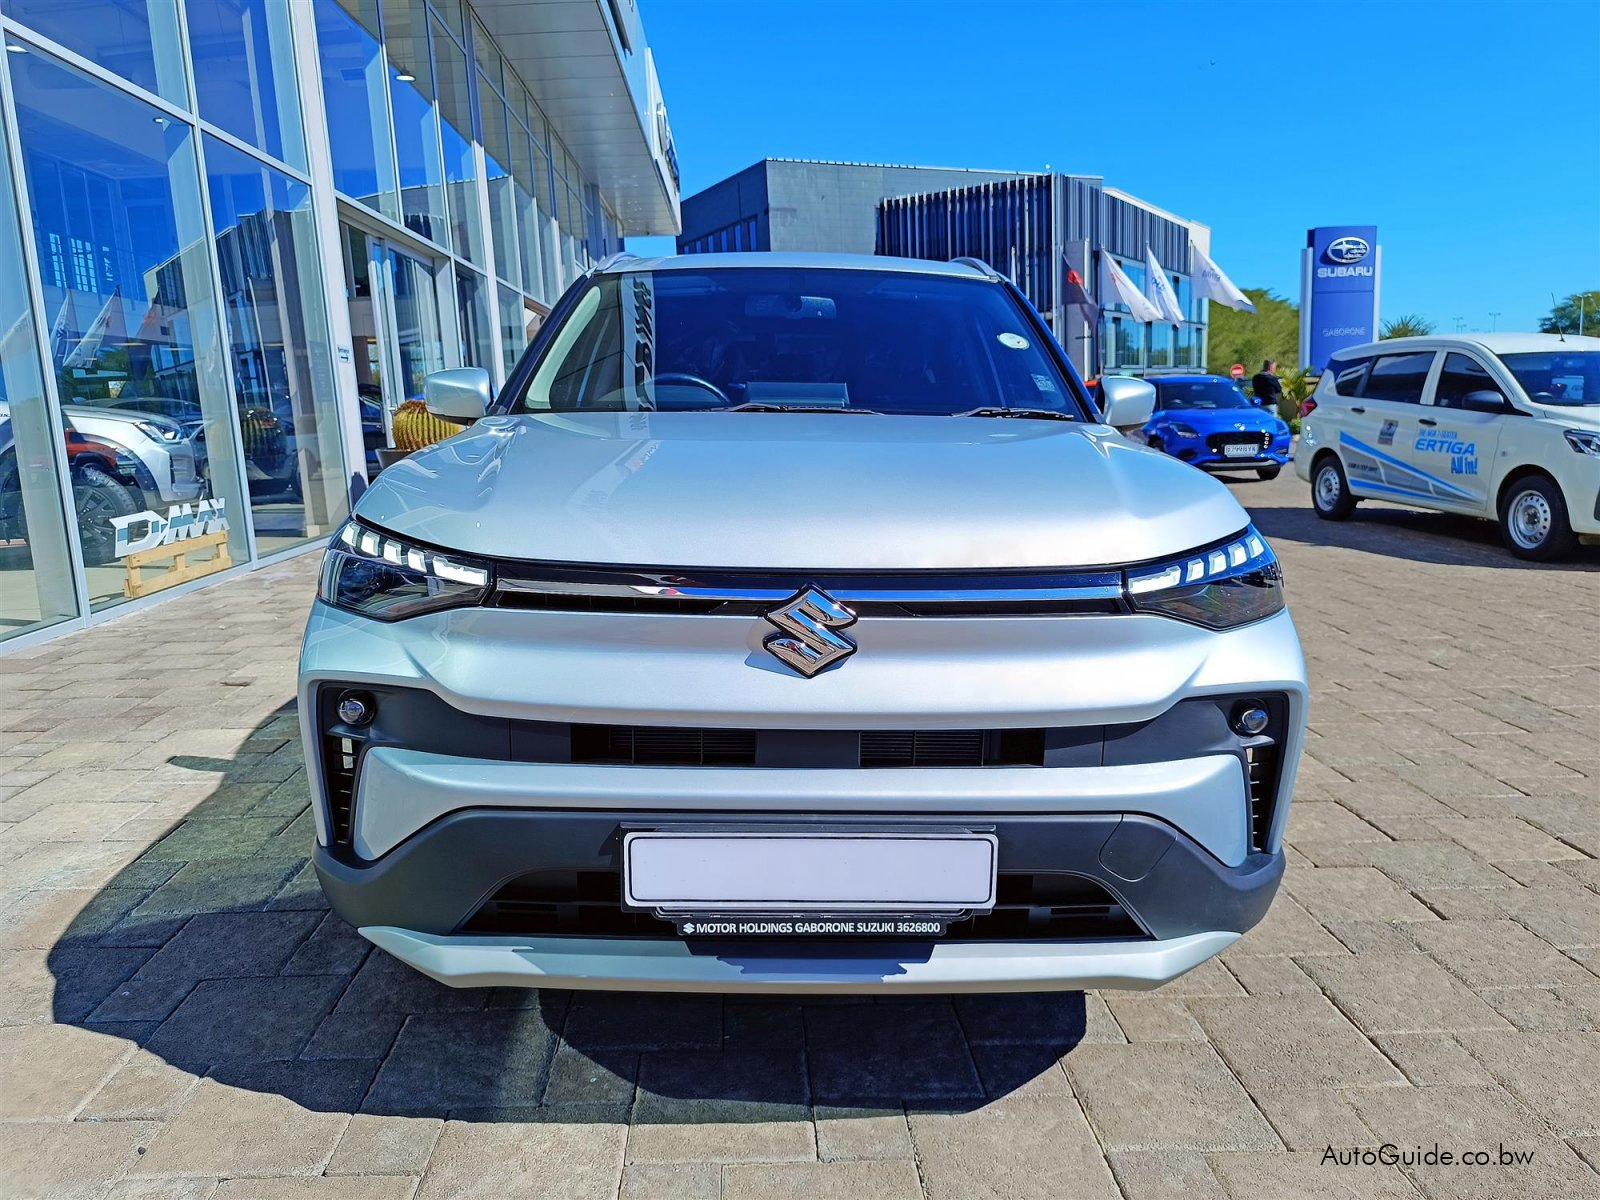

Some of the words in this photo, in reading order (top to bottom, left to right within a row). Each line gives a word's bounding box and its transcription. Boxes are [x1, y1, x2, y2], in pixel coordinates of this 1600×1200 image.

[1317, 266, 1373, 278] SUBARU
[1415, 438, 1475, 456] ERTIGA
[1451, 456, 1463, 474] All
[696, 922, 737, 933] MOTOR
[738, 922, 793, 933] HOLDINGS
[794, 922, 855, 933] GABORONE
[856, 922, 894, 933] SUZUKI
[896, 922, 941, 933] 3626800
